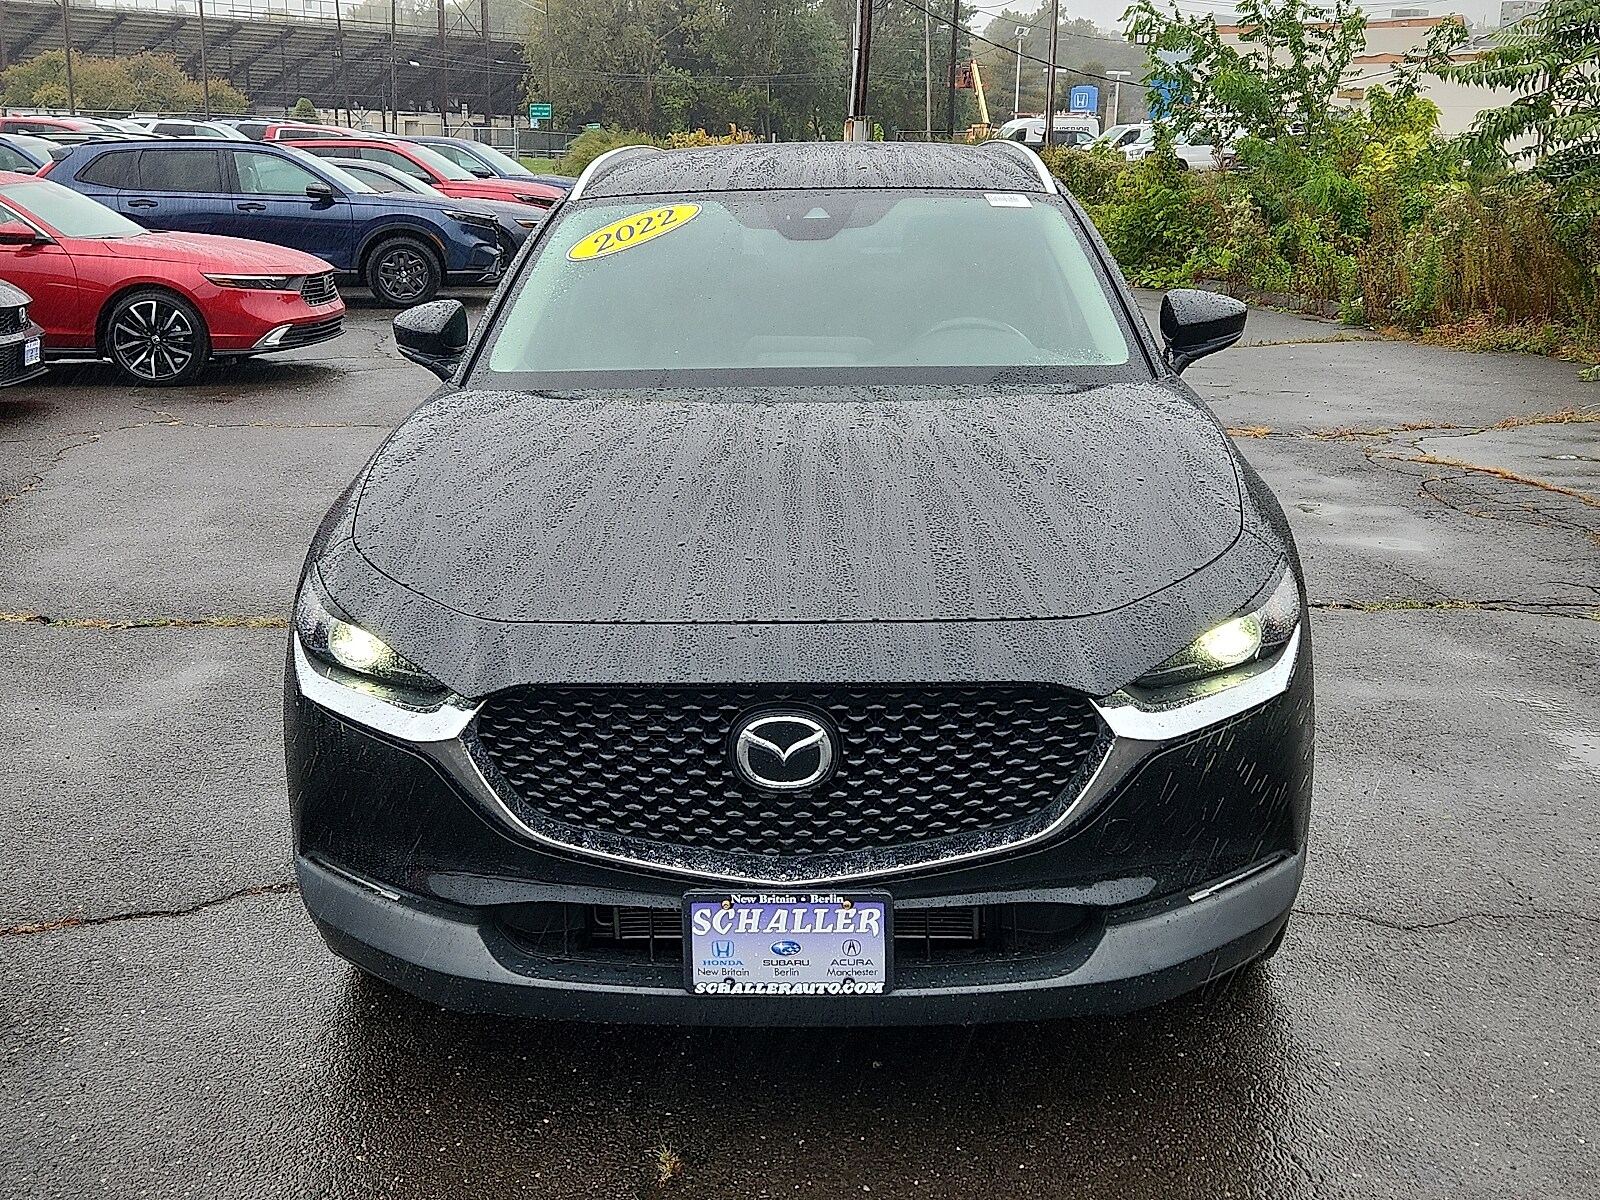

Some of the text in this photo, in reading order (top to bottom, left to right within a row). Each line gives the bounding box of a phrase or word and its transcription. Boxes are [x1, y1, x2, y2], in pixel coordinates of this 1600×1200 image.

[593, 209, 678, 253] 2022
[731, 894, 844, 904] New Britain Berlin
[692, 907, 881, 937] SCHALLER
[762, 959, 810, 967] SUBARU
[697, 968, 750, 977] New Britain
[774, 968, 800, 977] Berlin
[826, 968, 878, 977] Manchester
[694, 981, 885, 995] SCHALLERAUTO.COM
